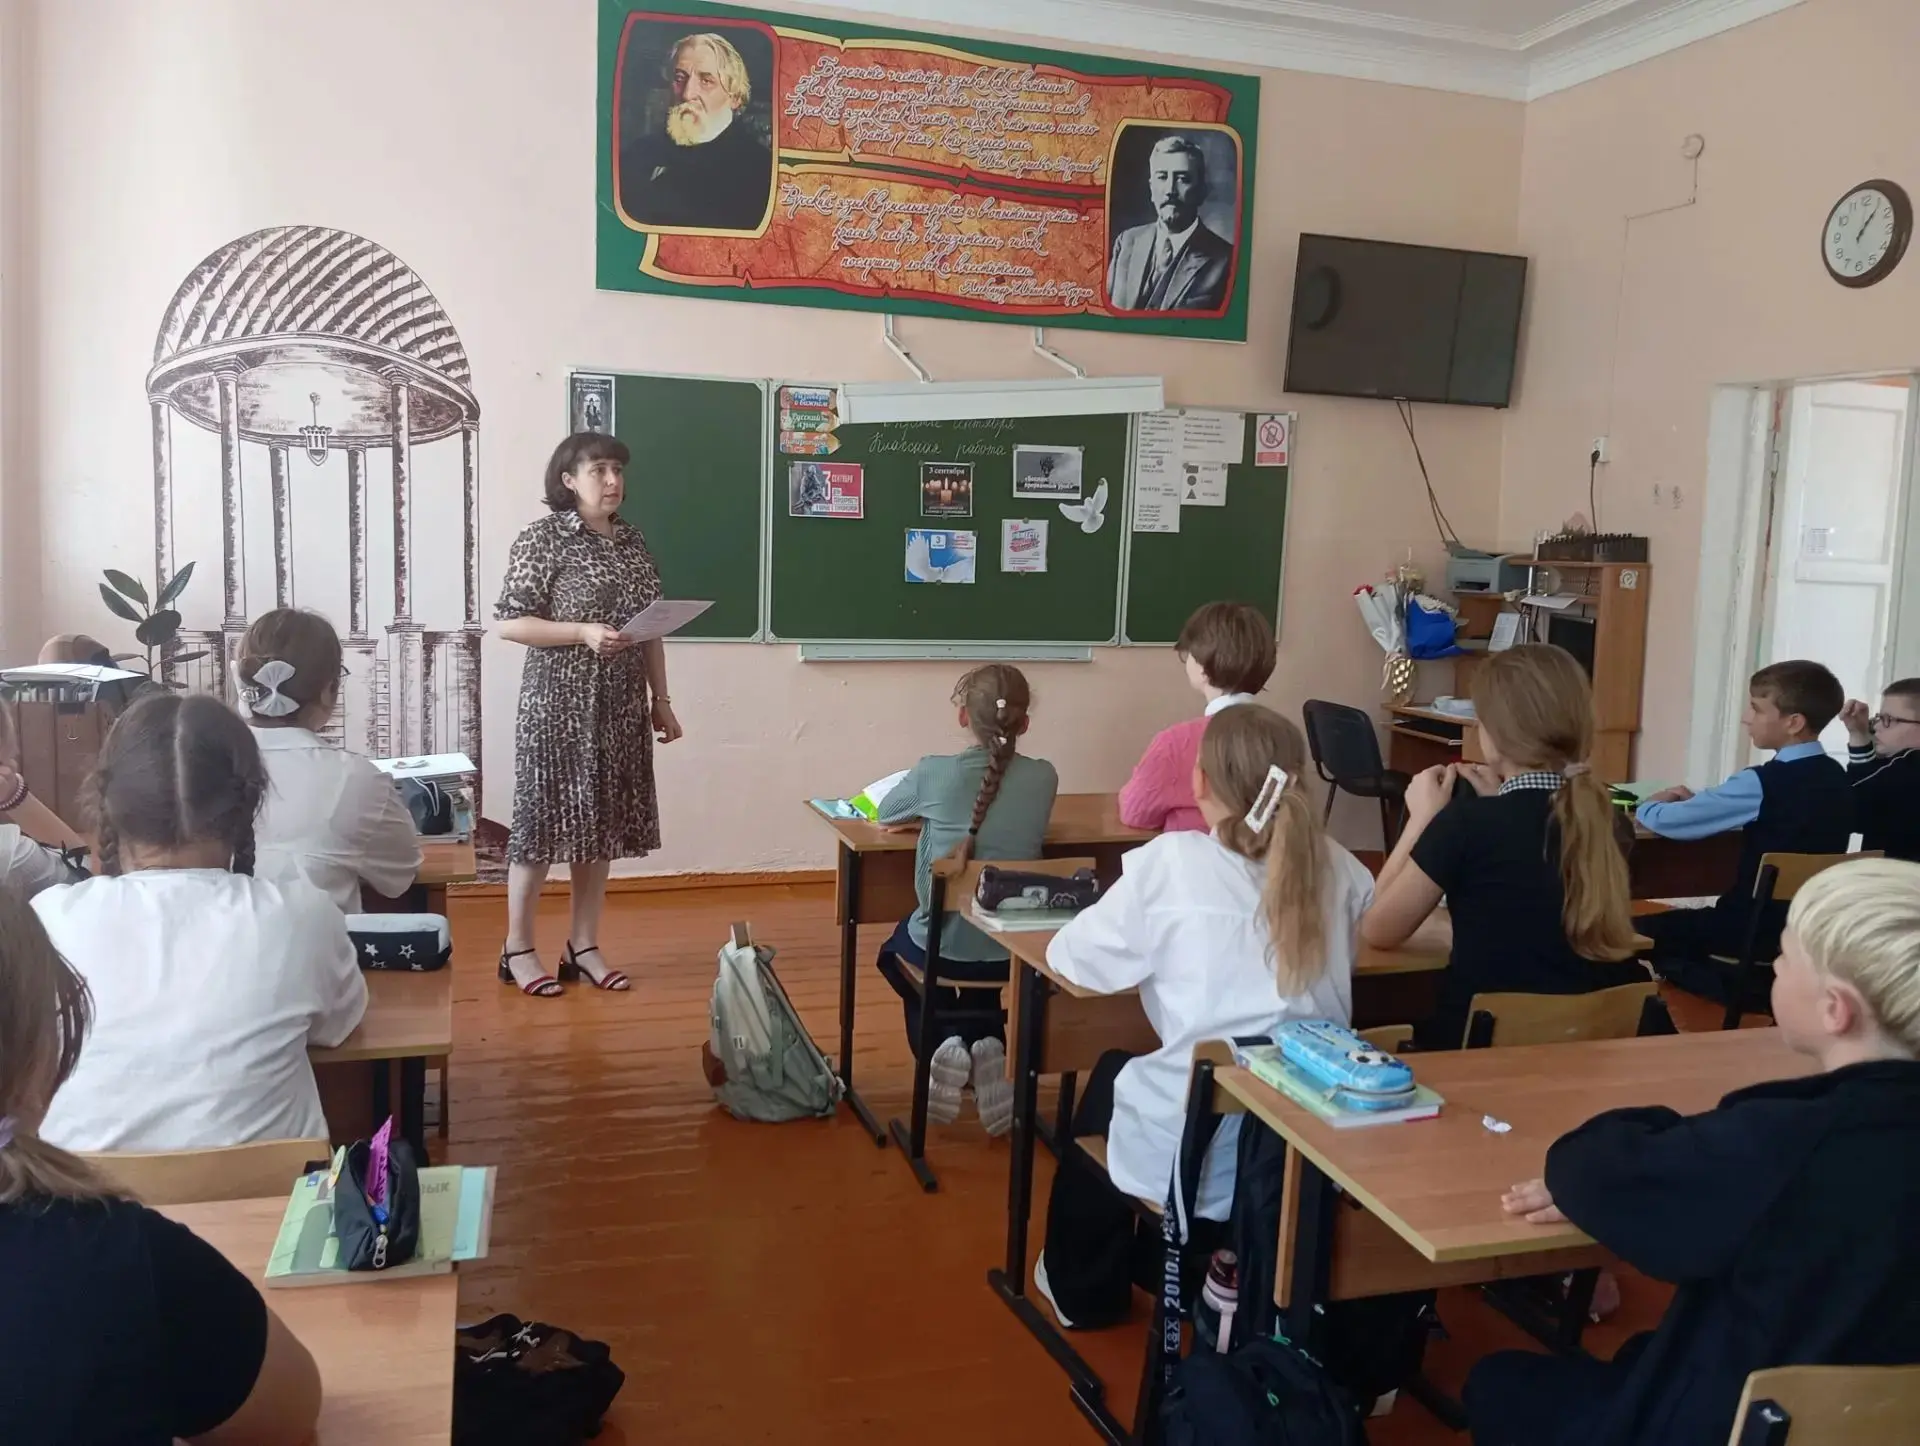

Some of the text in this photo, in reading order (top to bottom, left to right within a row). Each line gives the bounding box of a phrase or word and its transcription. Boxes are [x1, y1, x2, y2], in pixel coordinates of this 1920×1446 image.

[812, 55, 1075, 98] Берегите чистоту языка как святыню!
[795, 75, 860, 105] Никогда
[860, 88, 880, 100] не
[880, 83, 970, 107] употребляйте
[971, 97, 1051, 113] иностранных
[785, 93, 846, 130] Русский
[843, 101, 890, 129] язык
[880, 101, 920, 130] так
[908, 102, 948, 125] богат
[948, 116, 958, 127] и
[1001, 115, 1027, 131] что
[1027, 122, 1056, 134] нам
[1056, 122, 1100, 136] нечего
[853, 119, 1033, 159] брать у тех, кто беднее нас.
[781, 183, 836, 219] Русский
[836, 188, 881, 218] язык
[872, 188, 890, 211] в
[976, 196, 996, 217] в
[1849, 202, 1857, 213] 11
[1861, 195, 1872, 206] 12
[879, 200, 928, 221] умелых
[924, 194, 965, 227] руках
[964, 208, 976, 219] и
[988, 206, 1042, 222] опытных
[1039, 209, 1078, 230] устах
[1884, 207, 1892, 218] 2
[1838, 215, 1849, 228] 10
[1885, 223, 1893, 235] 3
[832, 218, 882, 250] красив,
[881, 219, 919, 254] певуч,
[923, 221, 1004, 252] выразителен,
[1833, 232, 1842, 243] 9
[1835, 248, 1844, 260] 8
[1879, 240, 1888, 251] 4
[840, 255, 901, 281] послушен,
[906, 250, 950, 279] ловок
[953, 252, 1034, 277] вместителен.
[1843, 258, 1852, 270] 7
[1854, 260, 1864, 272] 6
[1867, 254, 1878, 266] 5
[954, 439, 1007, 462] работа
[928, 466, 965, 477] 3 сентября
[822, 470, 832, 501] 3
[935, 535, 942, 544] 3
